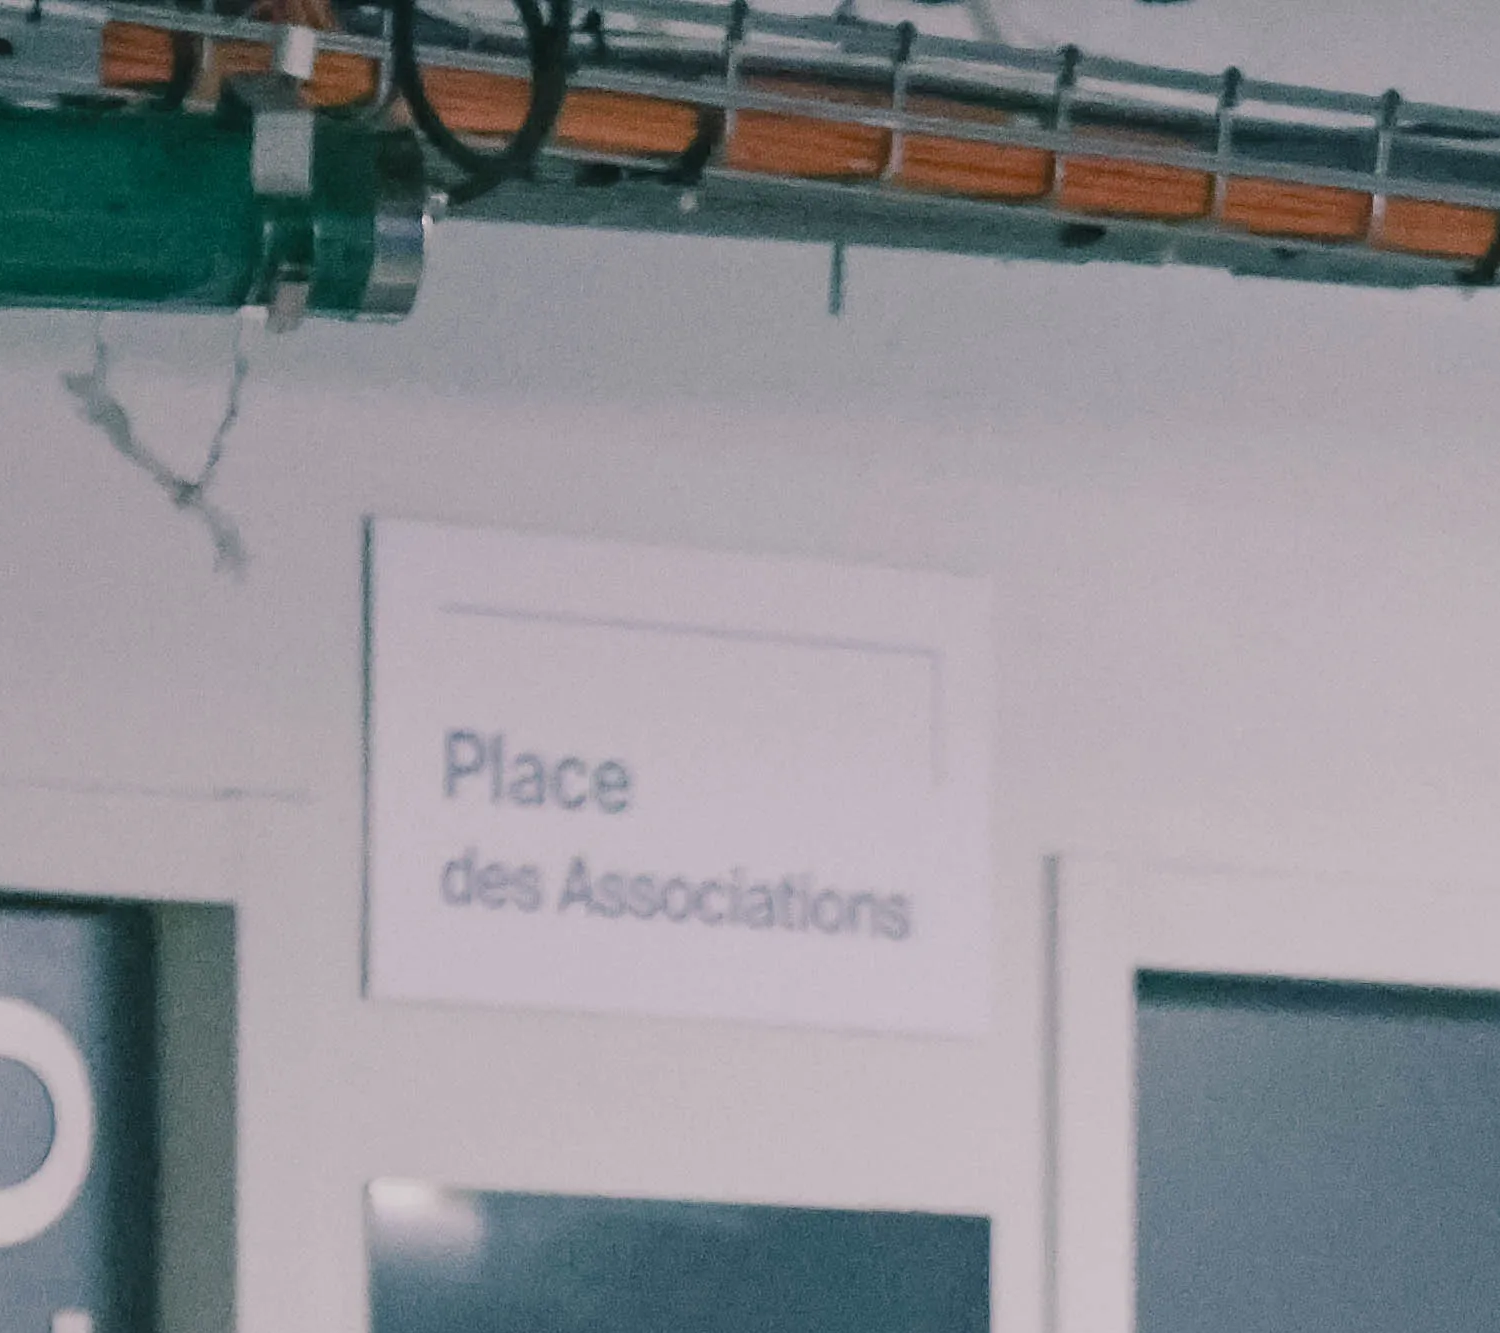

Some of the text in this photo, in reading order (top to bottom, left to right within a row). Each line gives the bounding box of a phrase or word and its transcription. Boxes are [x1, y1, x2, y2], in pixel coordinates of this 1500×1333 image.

[442, 728, 633, 813] Place
[440, 846, 913, 942] des Associations
